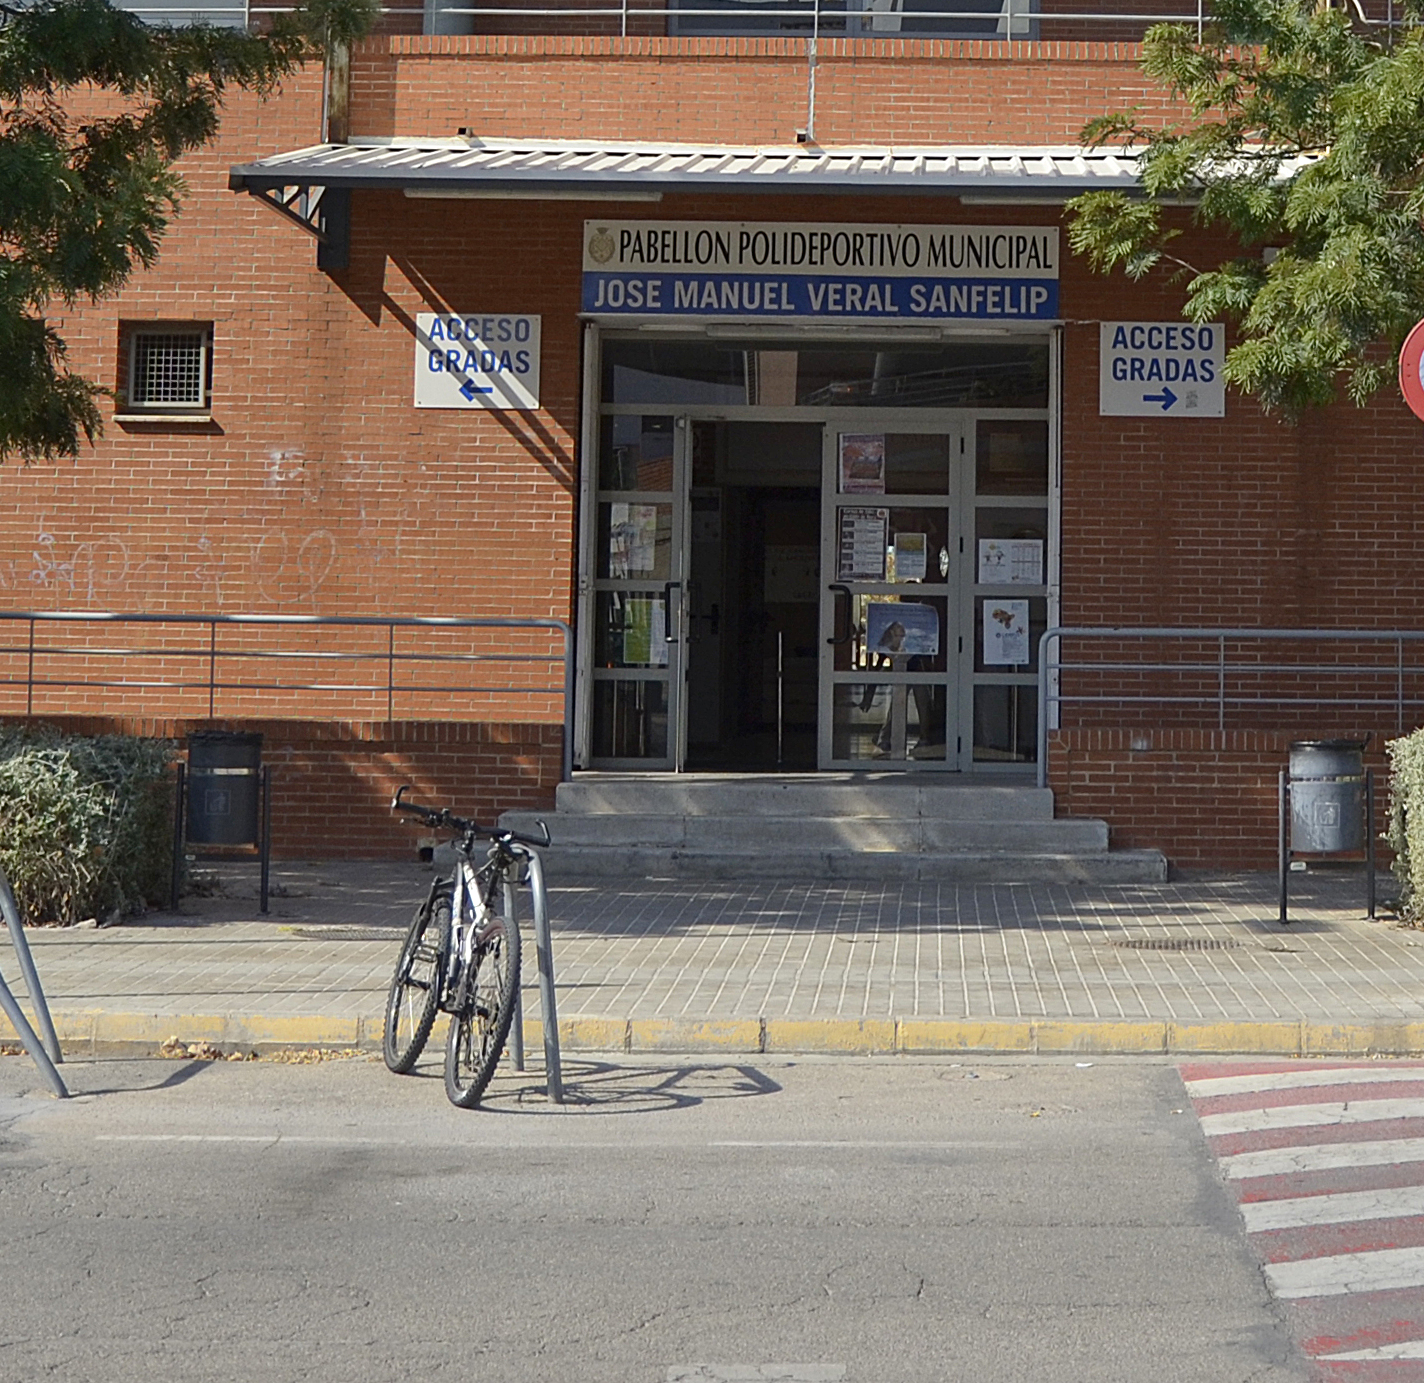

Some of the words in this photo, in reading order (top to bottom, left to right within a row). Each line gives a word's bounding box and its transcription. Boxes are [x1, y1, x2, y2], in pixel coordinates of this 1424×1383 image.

[619, 229, 731, 265] PABELLON
[738, 230, 921, 267] POLIDEPORTIVO
[927, 234, 1053, 269] MUNICIPAL
[594, 278, 662, 308] JOSE
[674, 280, 796, 311] MANUEL
[807, 283, 899, 313] VERAL
[909, 284, 1049, 314] SANFELIP
[428, 318, 531, 342] ACCESO
[1111, 325, 1214, 351] ACCESO
[427, 349, 531, 374] GRADAS
[1111, 357, 1215, 383] GRADAS
